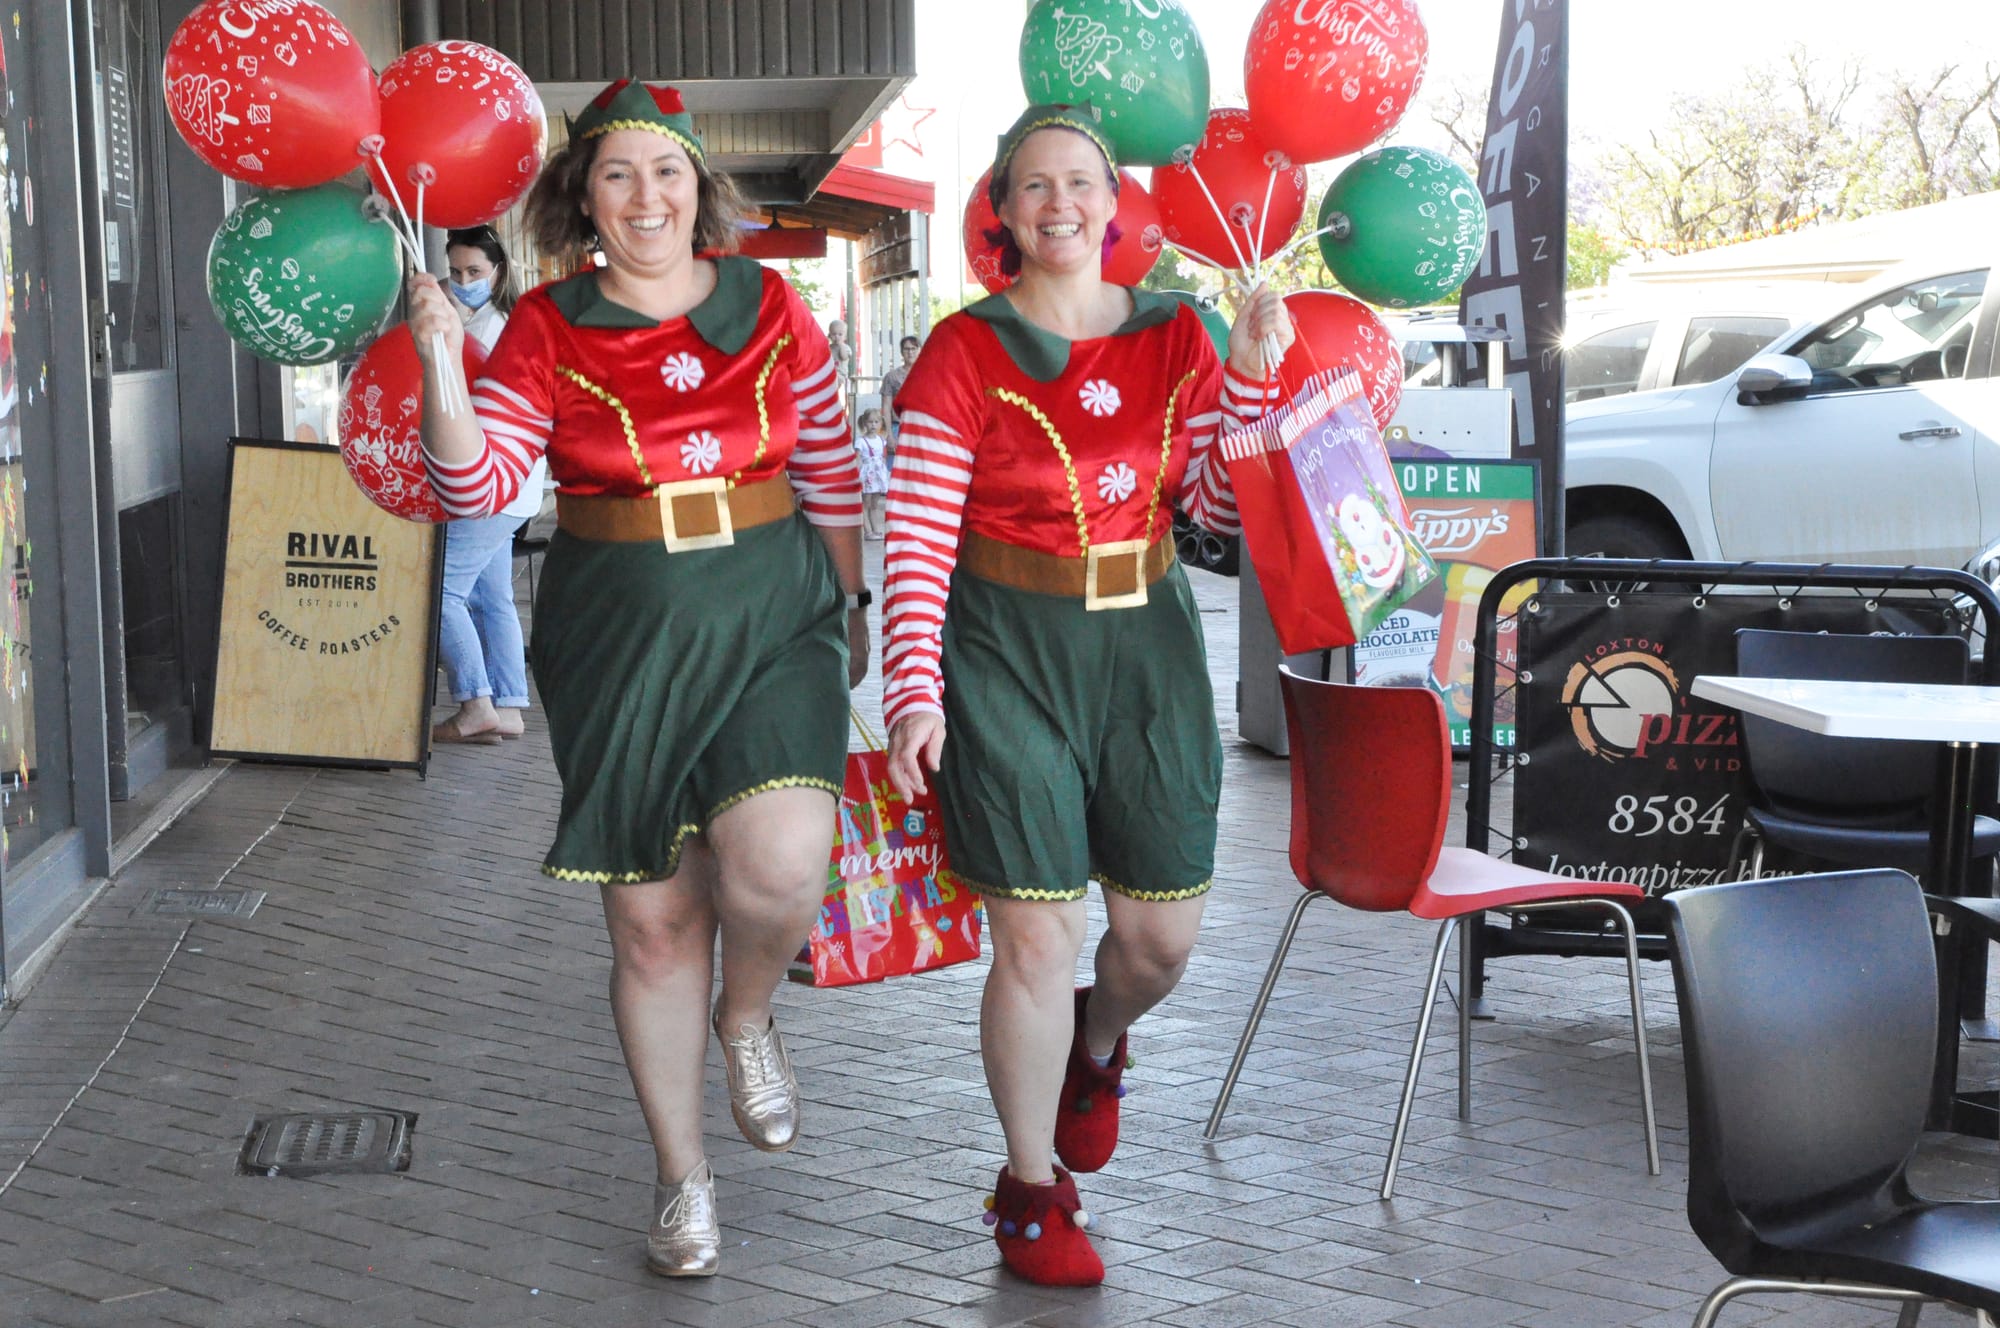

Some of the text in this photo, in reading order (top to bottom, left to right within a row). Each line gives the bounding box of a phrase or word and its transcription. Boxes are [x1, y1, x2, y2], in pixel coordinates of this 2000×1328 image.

[1524, 0, 1554, 373] RGANIC
[1437, 187, 1476, 287] Christmas
[242, 267, 336, 360] Christmas
[1403, 465, 1481, 493] OPEN
[287, 532, 378, 561] RIVAL
[1410, 507, 1509, 553] ippy's
[286, 572, 377, 592] BROTHERS
[298, 598, 320, 608] EST
[257, 610, 401, 656] COFFEE ROASTERS
[1354, 629, 1440, 650] HOCOLATE
[1585, 637, 1665, 663] LOXTON
[1631, 696, 1739, 759] piz
[1665, 756, 1742, 772] & VID
[833, 799, 894, 847] AVE
[907, 816, 922, 833] a
[1607, 793, 1732, 837] 8584
[839, 843, 944, 880] merry
[818, 870, 957, 938] CHRISTMAS
